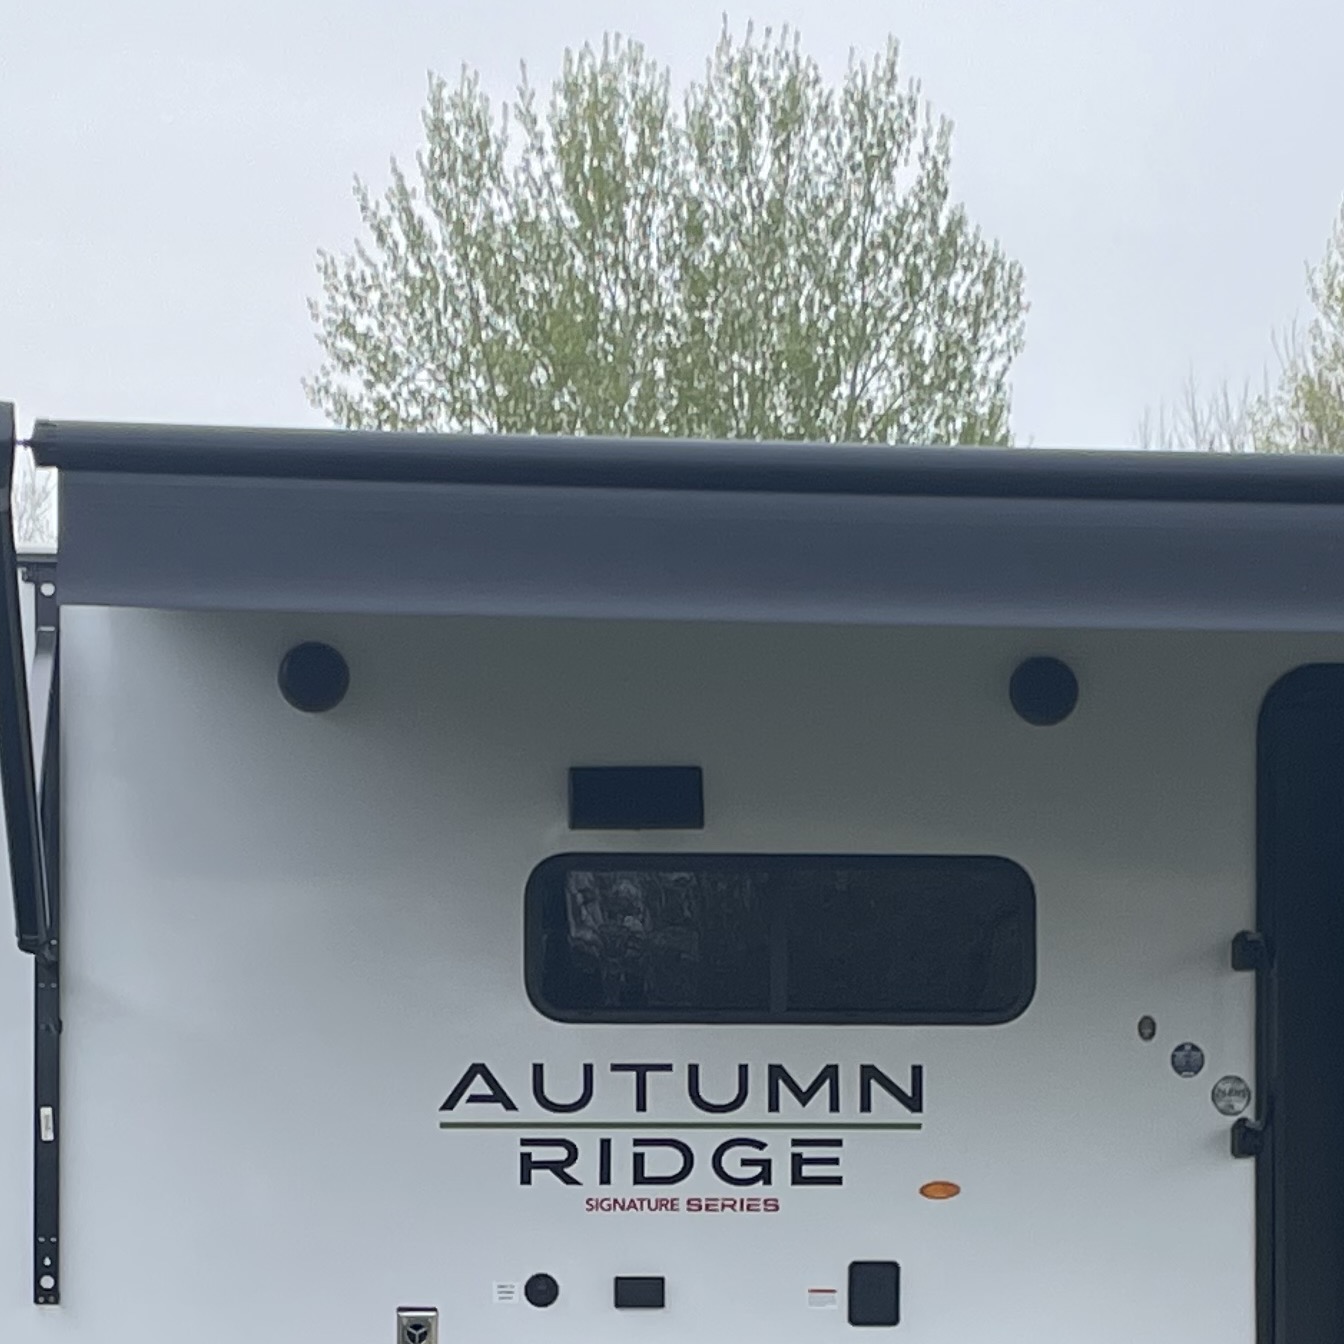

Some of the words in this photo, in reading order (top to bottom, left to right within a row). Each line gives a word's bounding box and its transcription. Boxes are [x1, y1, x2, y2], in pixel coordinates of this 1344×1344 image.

[438, 1062, 924, 1114] AUTUMN
[519, 1137, 844, 1187] RIDGE
[585, 1197, 680, 1213] SIGNATURE
[686, 1197, 781, 1213] SERIES
